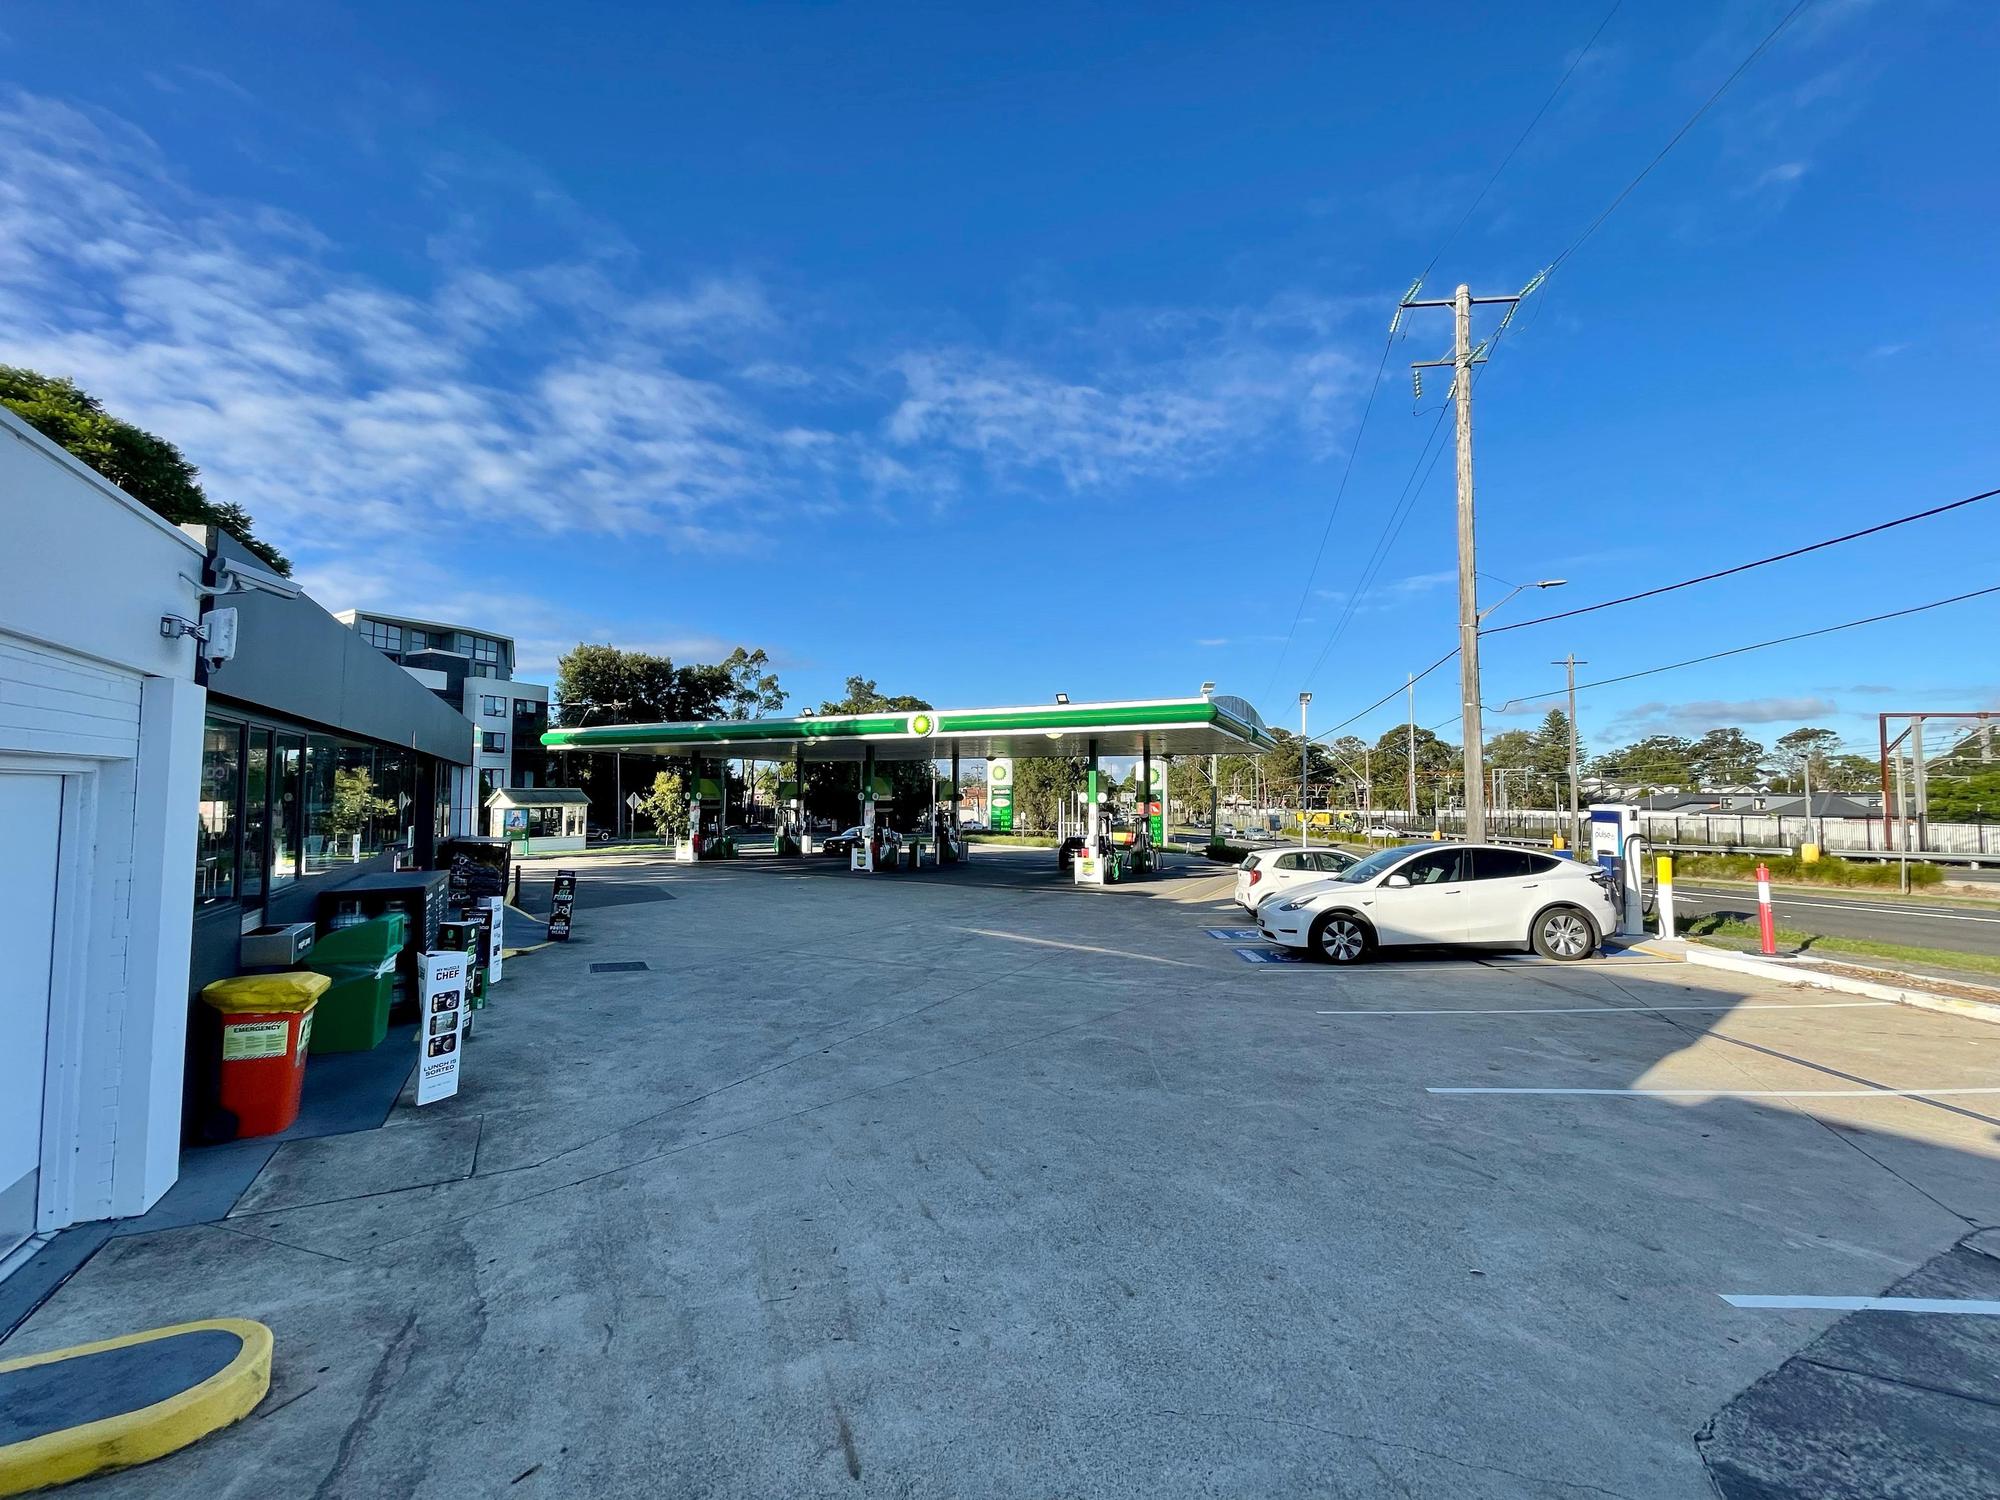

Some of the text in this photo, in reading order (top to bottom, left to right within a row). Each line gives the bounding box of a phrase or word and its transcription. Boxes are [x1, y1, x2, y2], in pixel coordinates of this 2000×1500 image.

[436, 969, 460, 981] CHEF
[233, 1024, 282, 1034] EMERGENCY
[423, 1061, 450, 1072] LUNCH
[425, 1064, 455, 1077] SORTED
